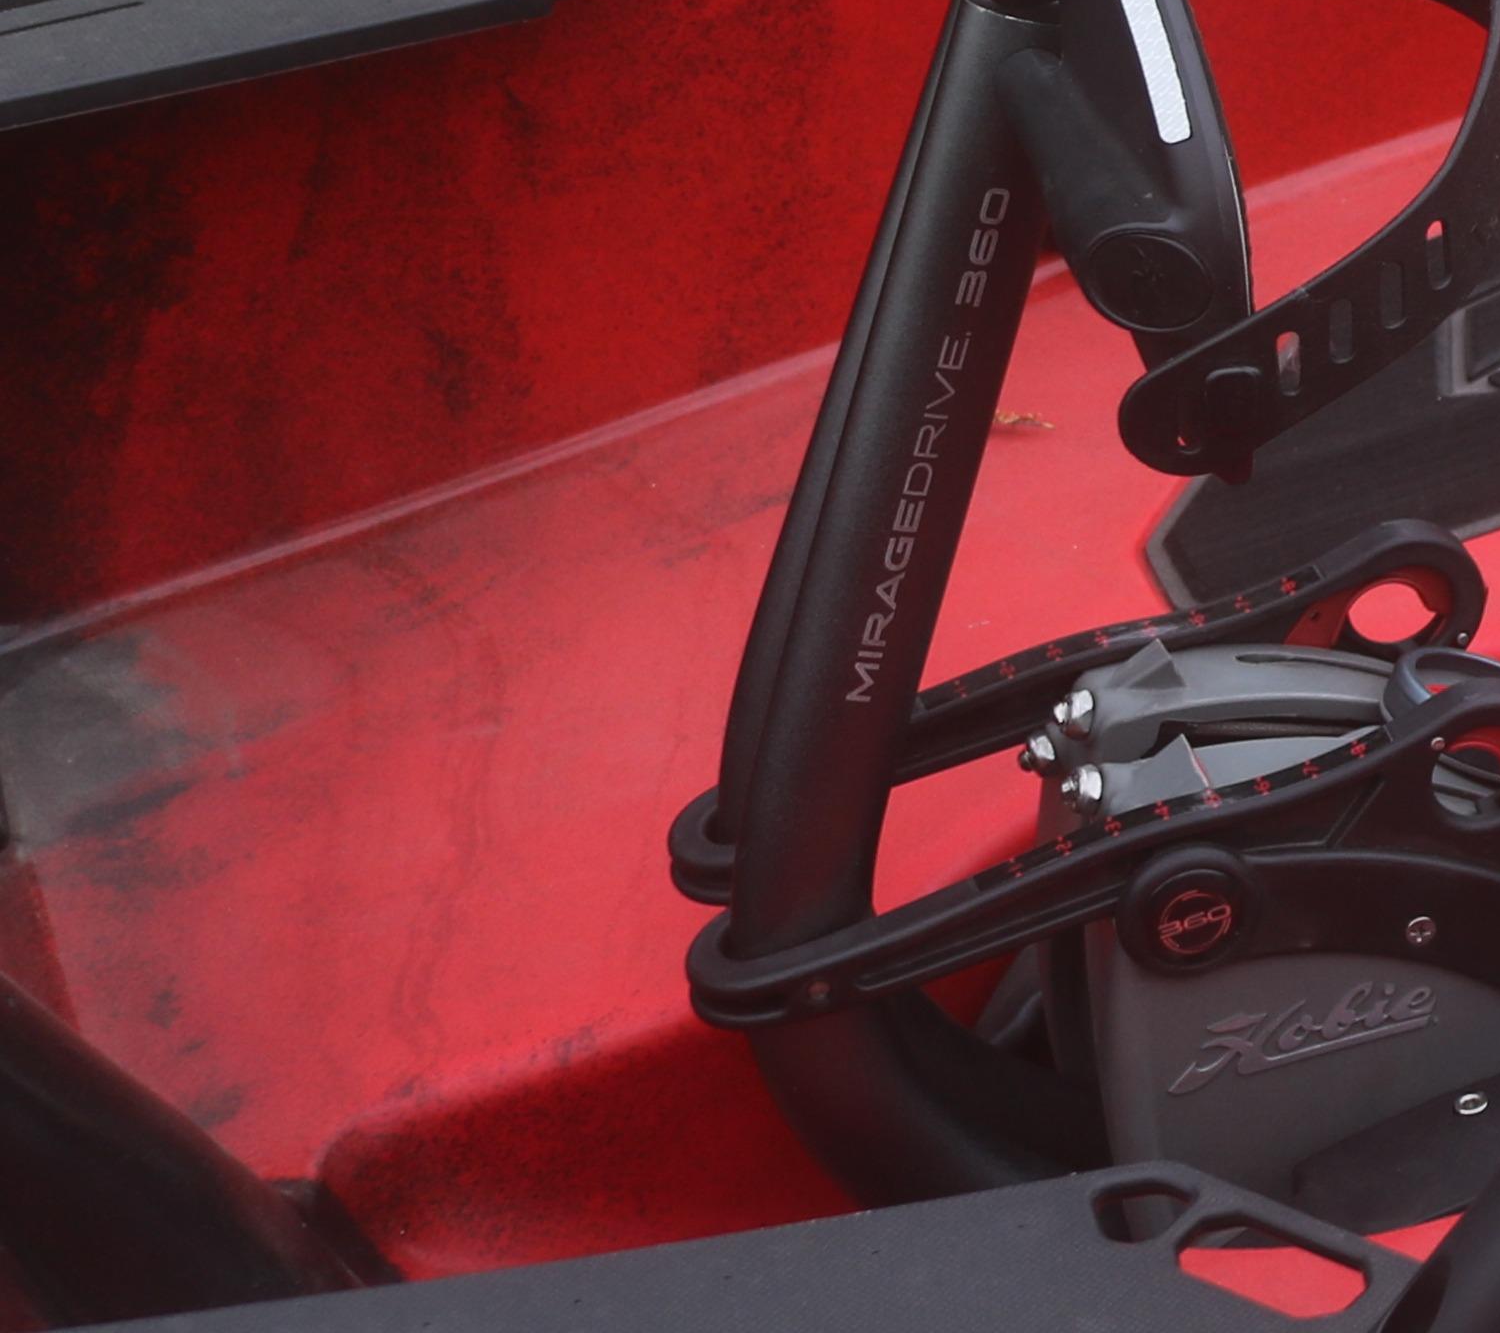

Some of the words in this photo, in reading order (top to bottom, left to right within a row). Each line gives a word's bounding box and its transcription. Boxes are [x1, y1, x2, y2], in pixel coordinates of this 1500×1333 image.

[955, 187, 1011, 307] 360
[1158, 903, 1232, 935] 360
[1167, 980, 1438, 1096] Hobie
